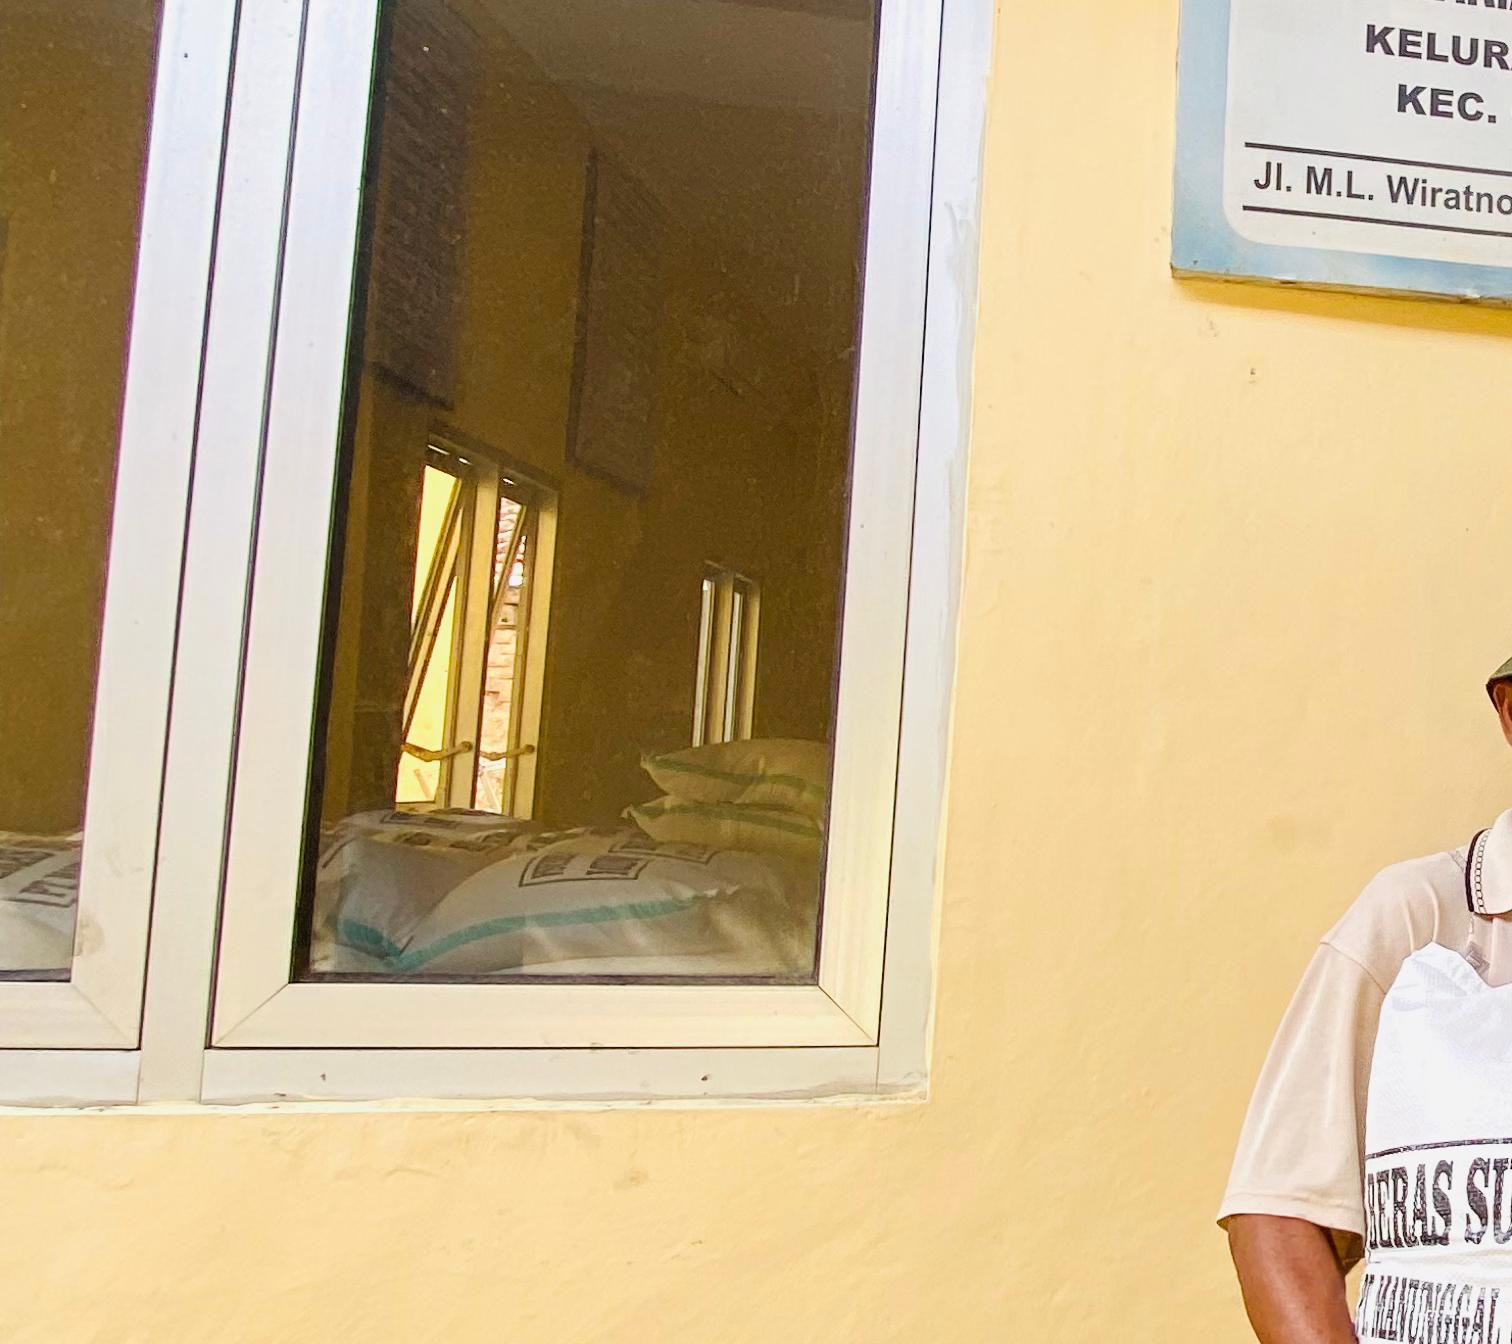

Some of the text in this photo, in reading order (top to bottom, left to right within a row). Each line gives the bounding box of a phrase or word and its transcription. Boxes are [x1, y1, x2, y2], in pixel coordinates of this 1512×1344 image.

[1397, 84, 1497, 123] KEC.
[1254, 161, 1292, 192] Jl.
[1306, 165, 1374, 201] M.L.
